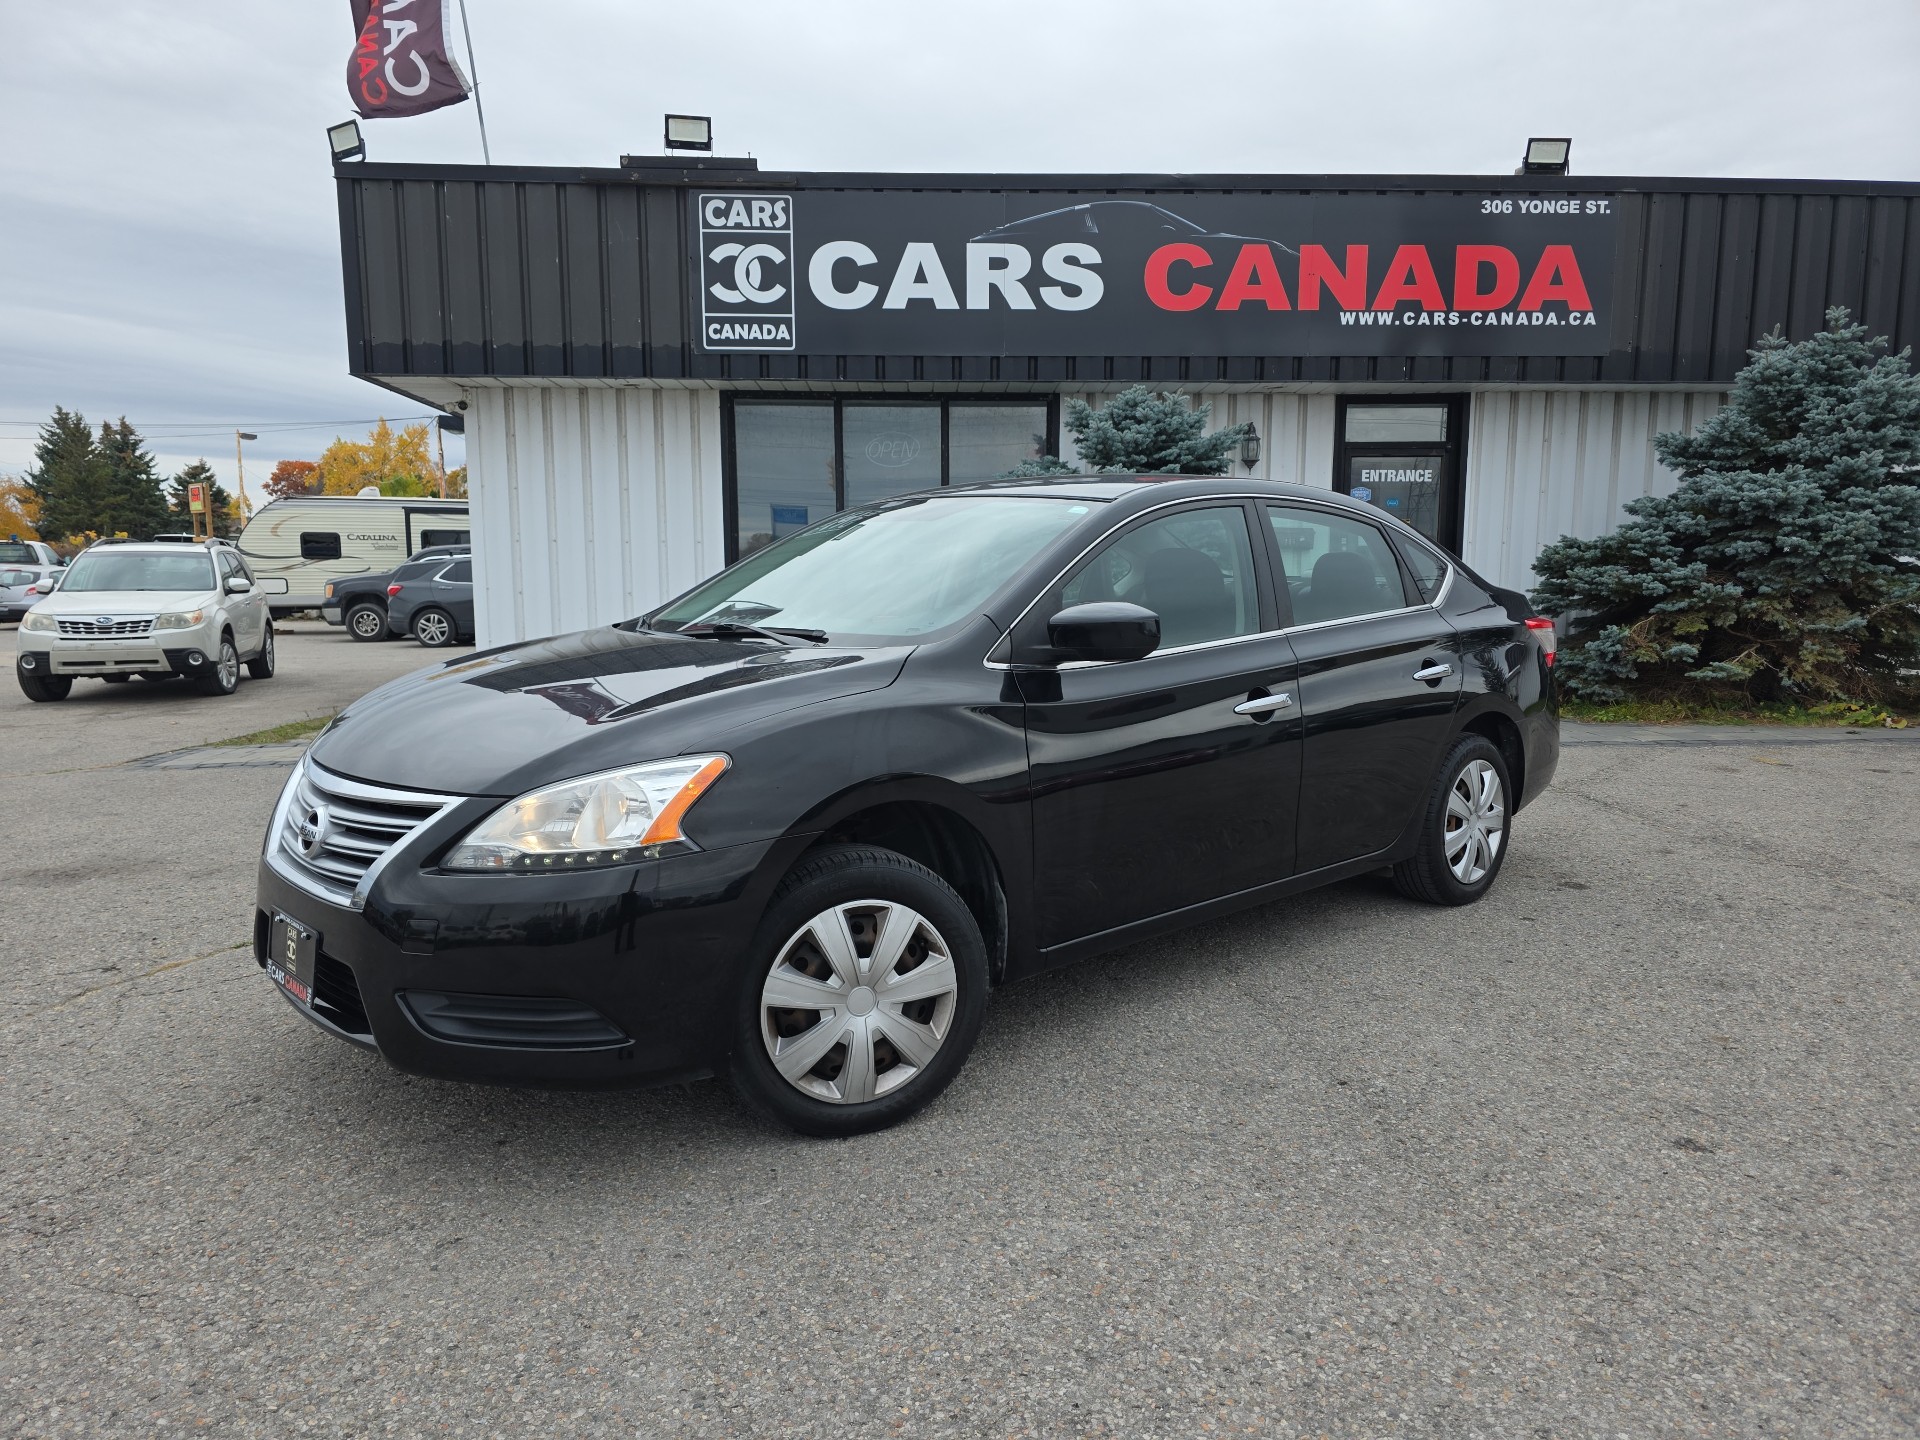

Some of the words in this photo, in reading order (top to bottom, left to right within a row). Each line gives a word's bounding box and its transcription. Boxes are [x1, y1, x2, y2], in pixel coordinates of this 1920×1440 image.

[704, 198, 787, 228] CARS
[1481, 199, 1513, 214] 306
[1518, 199, 1581, 214] YONGE
[1585, 199, 1611, 214] ST.
[808, 240, 1104, 311] CARS
[1144, 242, 1594, 312] CANADA
[1339, 311, 1597, 326] WWW.CARS-CANADA.CA
[708, 323, 791, 340] CANADA
[868, 441, 915, 458] OPEN
[1361, 469, 1433, 482] ENTRANCE
[346, 533, 398, 541] CATALINA
[271, 966, 285, 985] CARS
[285, 975, 307, 1003] CANADA
